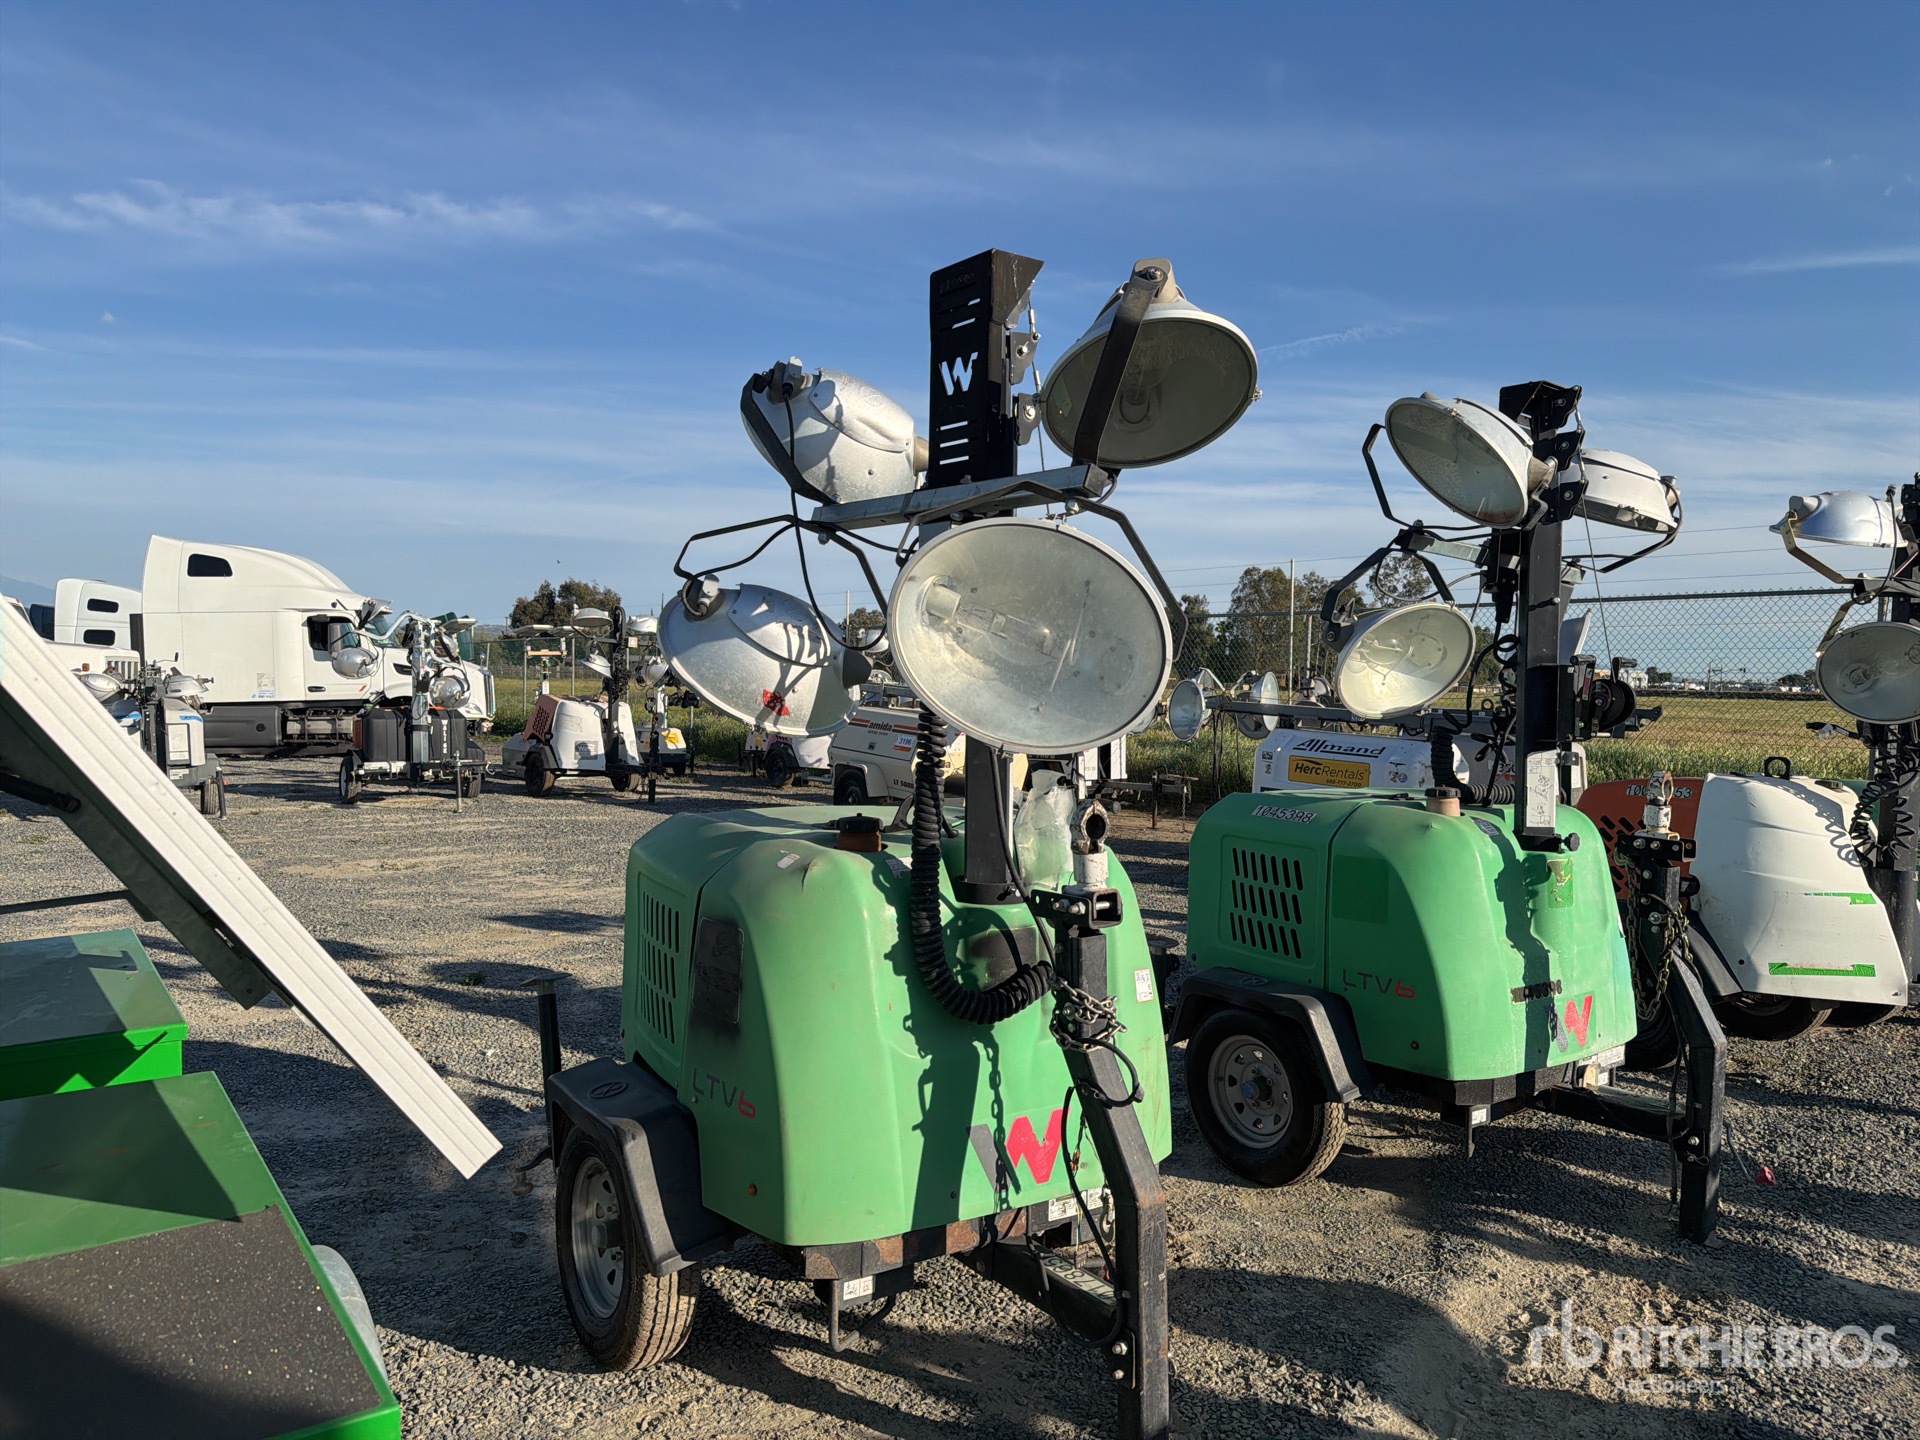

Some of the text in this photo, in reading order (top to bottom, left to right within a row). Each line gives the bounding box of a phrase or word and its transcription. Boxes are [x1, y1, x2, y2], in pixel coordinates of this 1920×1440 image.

[869, 722, 892, 732] amida
[898, 737, 912, 746] 3196
[1296, 738, 1386, 756] Allmand
[1294, 762, 1365, 781] HercRentals
[893, 778, 899, 786] LT
[1628, 785, 1692, 799] 10053
[1343, 969, 1416, 999] LTV6
[692, 1067, 756, 1119] LTV6
